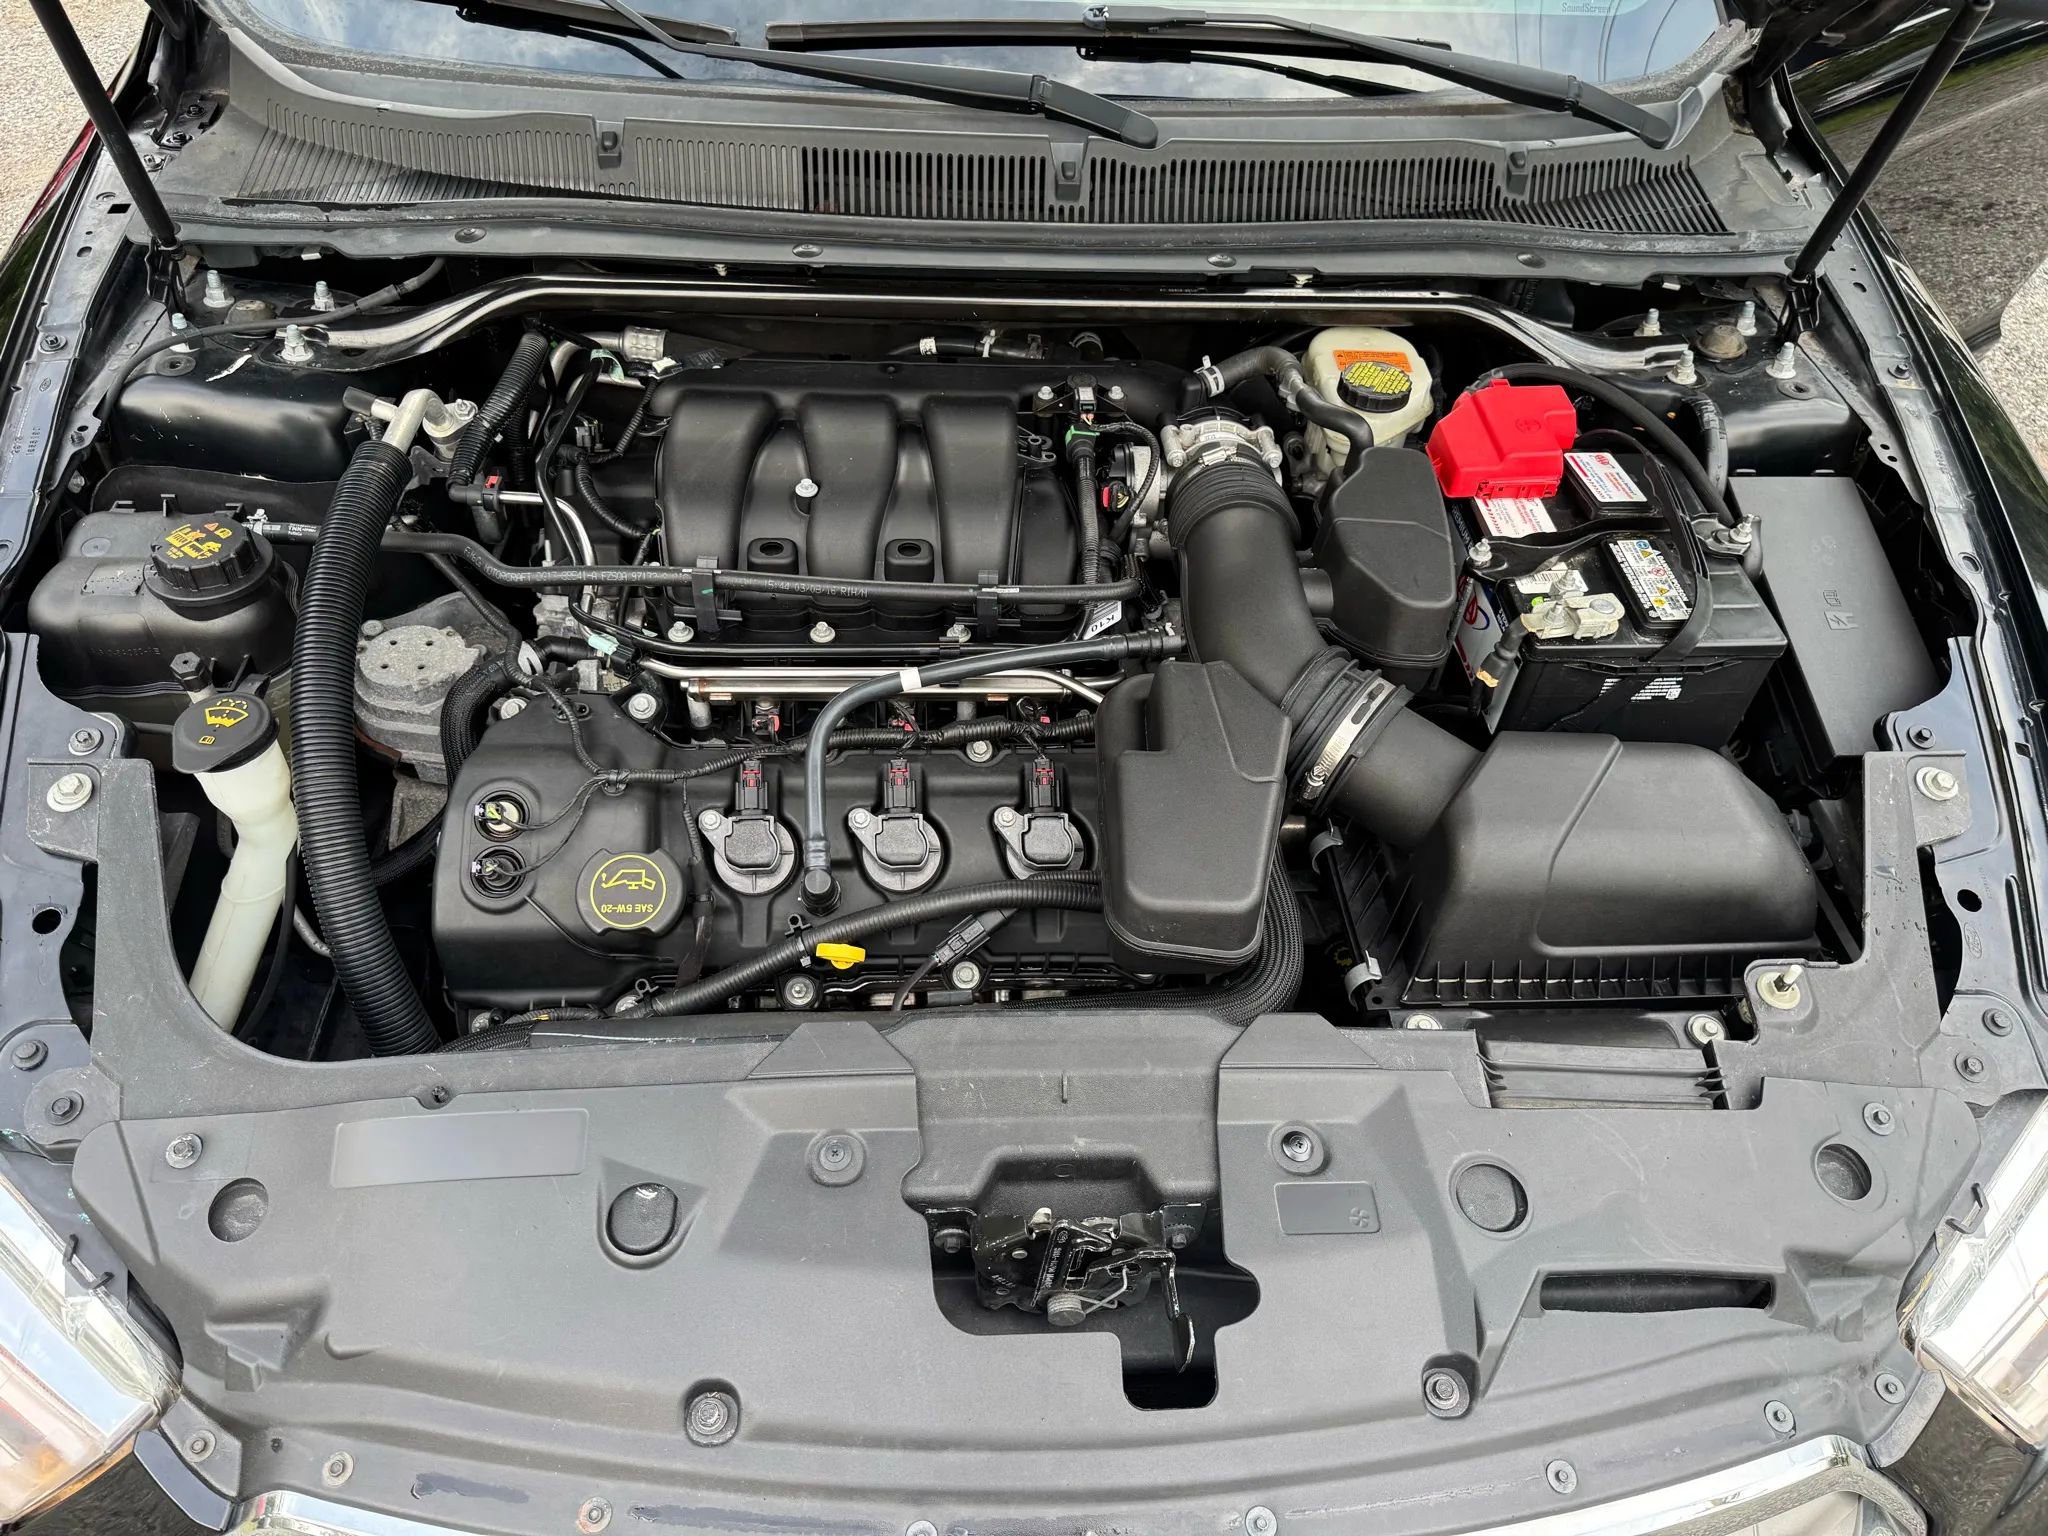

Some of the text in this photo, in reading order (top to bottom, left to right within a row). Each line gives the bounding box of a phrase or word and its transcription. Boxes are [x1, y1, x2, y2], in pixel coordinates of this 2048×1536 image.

[1561, 2, 1610, 13] SoundScreen
[600, 903, 654, 914] SAE 5W-20
